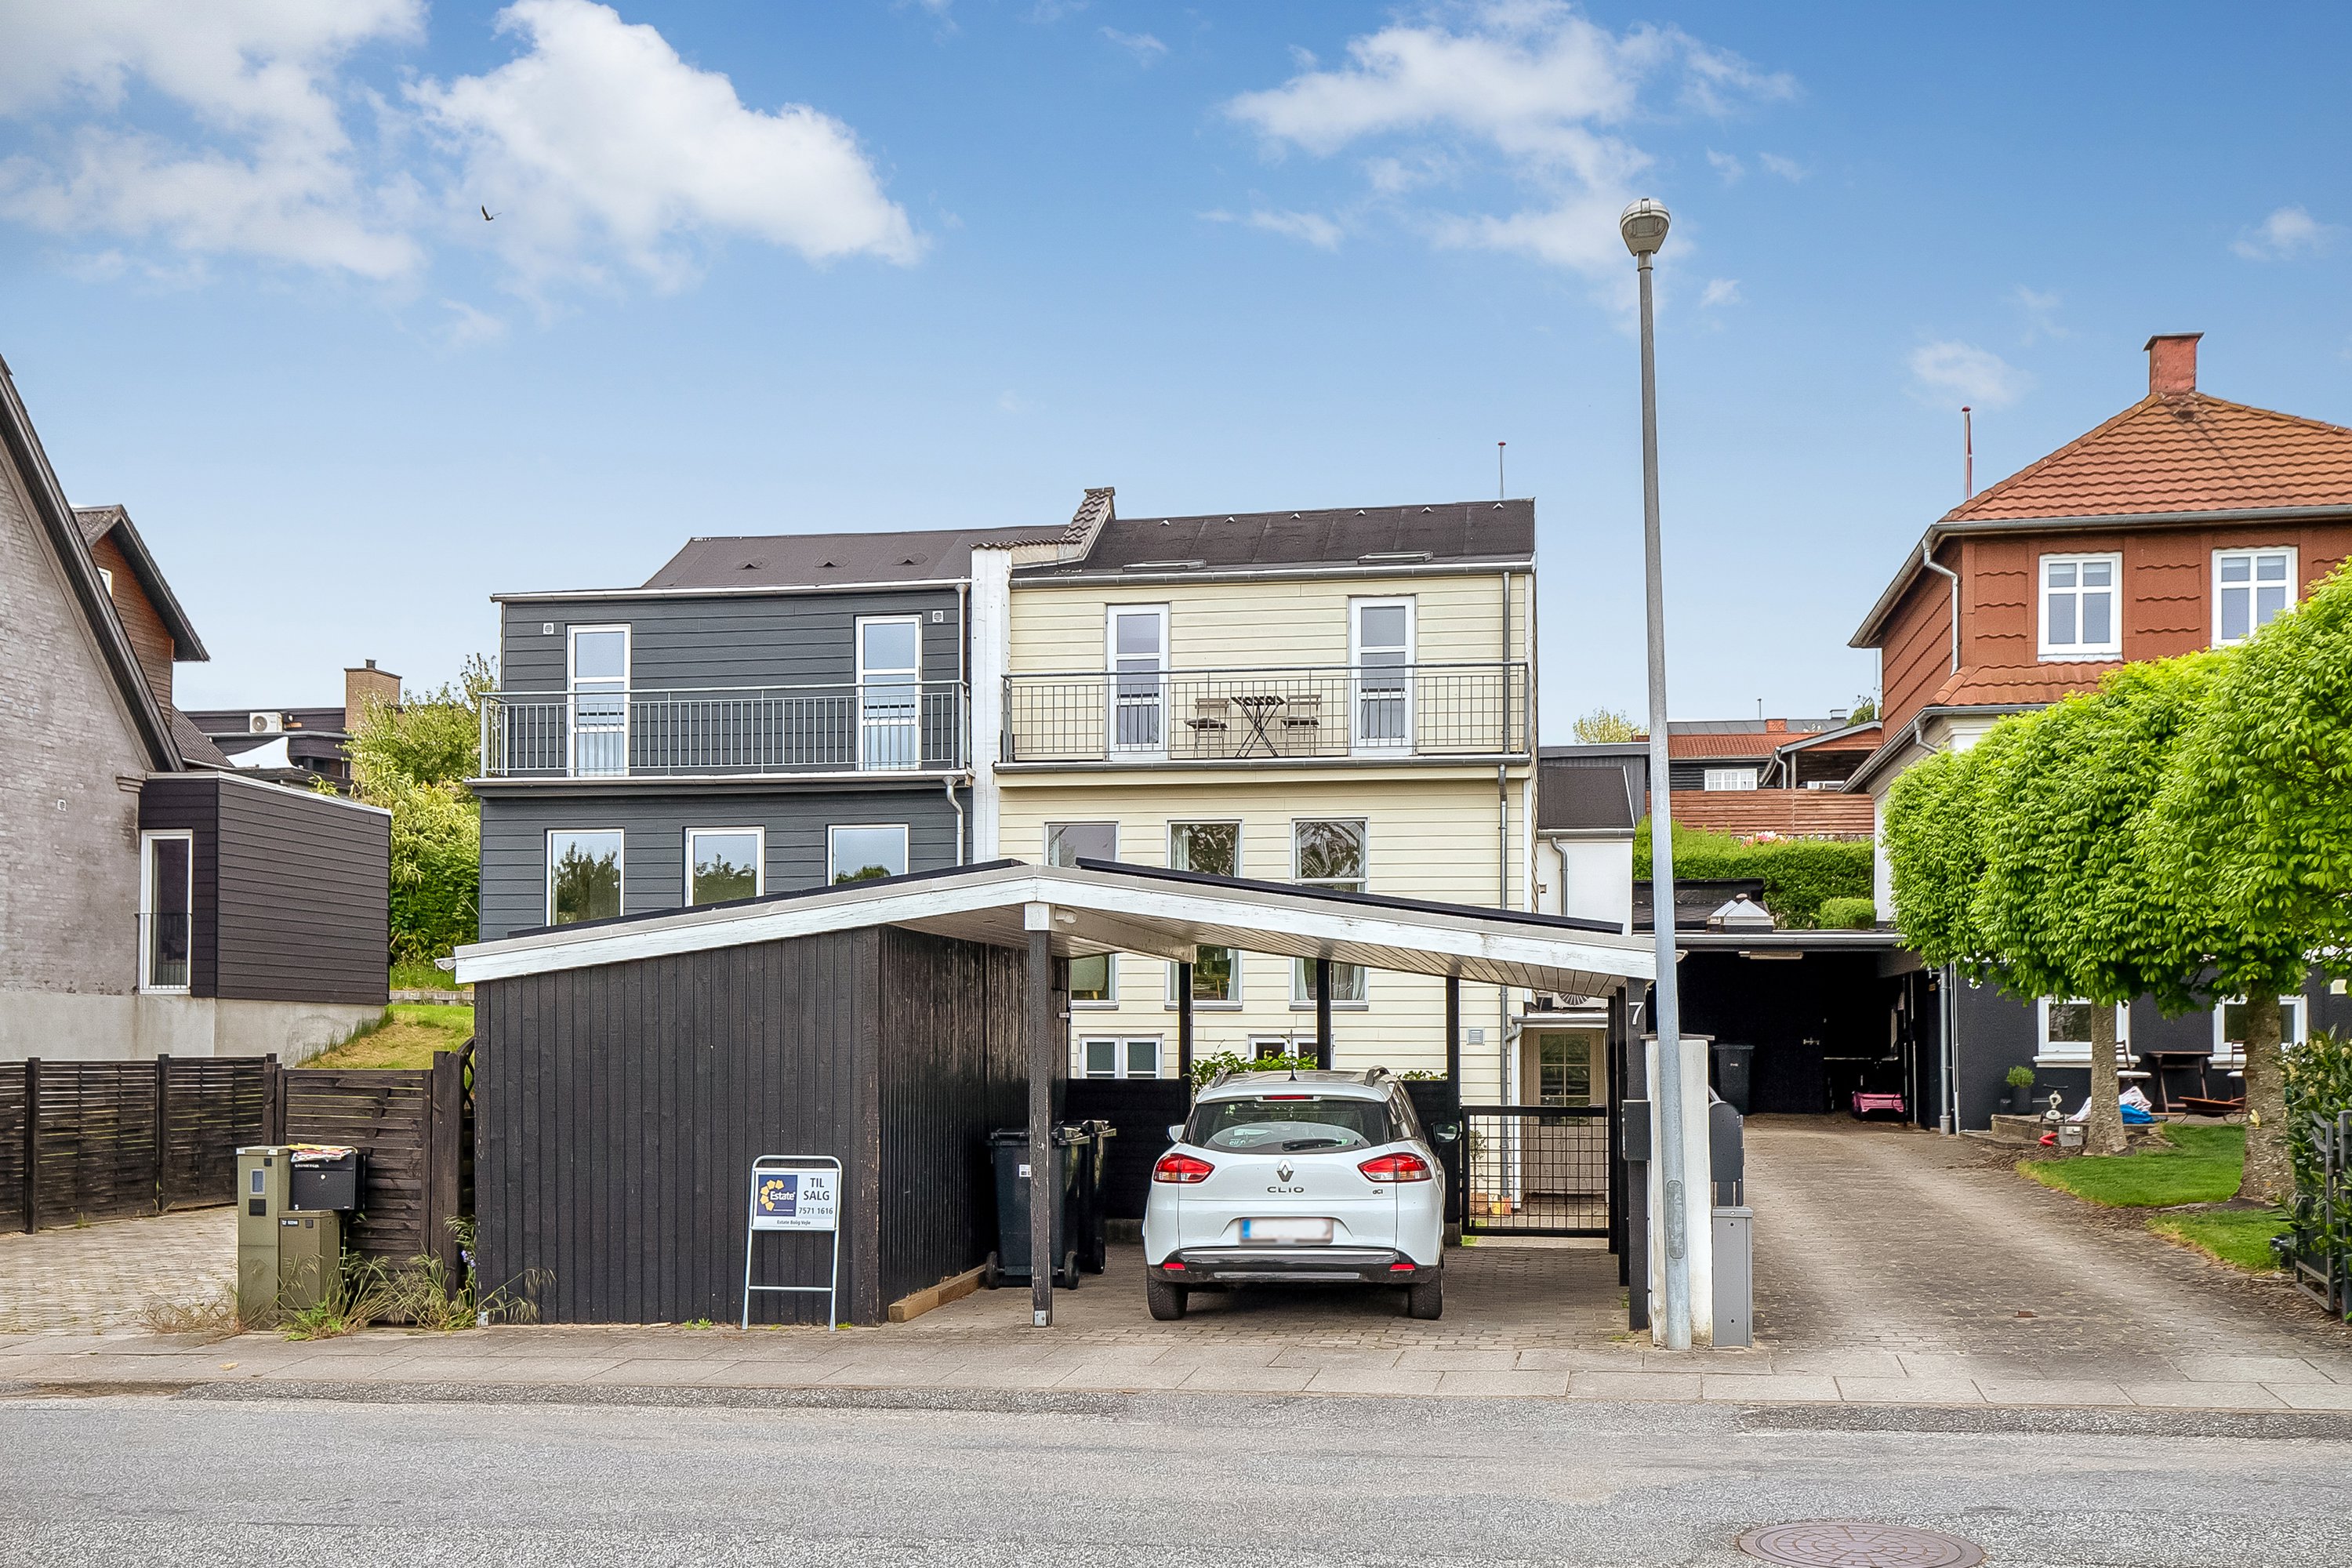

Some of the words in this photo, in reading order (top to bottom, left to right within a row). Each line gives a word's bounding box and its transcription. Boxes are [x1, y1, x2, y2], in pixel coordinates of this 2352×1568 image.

[1628, 1001, 1645, 1025] 7
[810, 1178, 825, 1188] TIL
[770, 1190, 796, 1201] Estate
[803, 1190, 830, 1201] SALG
